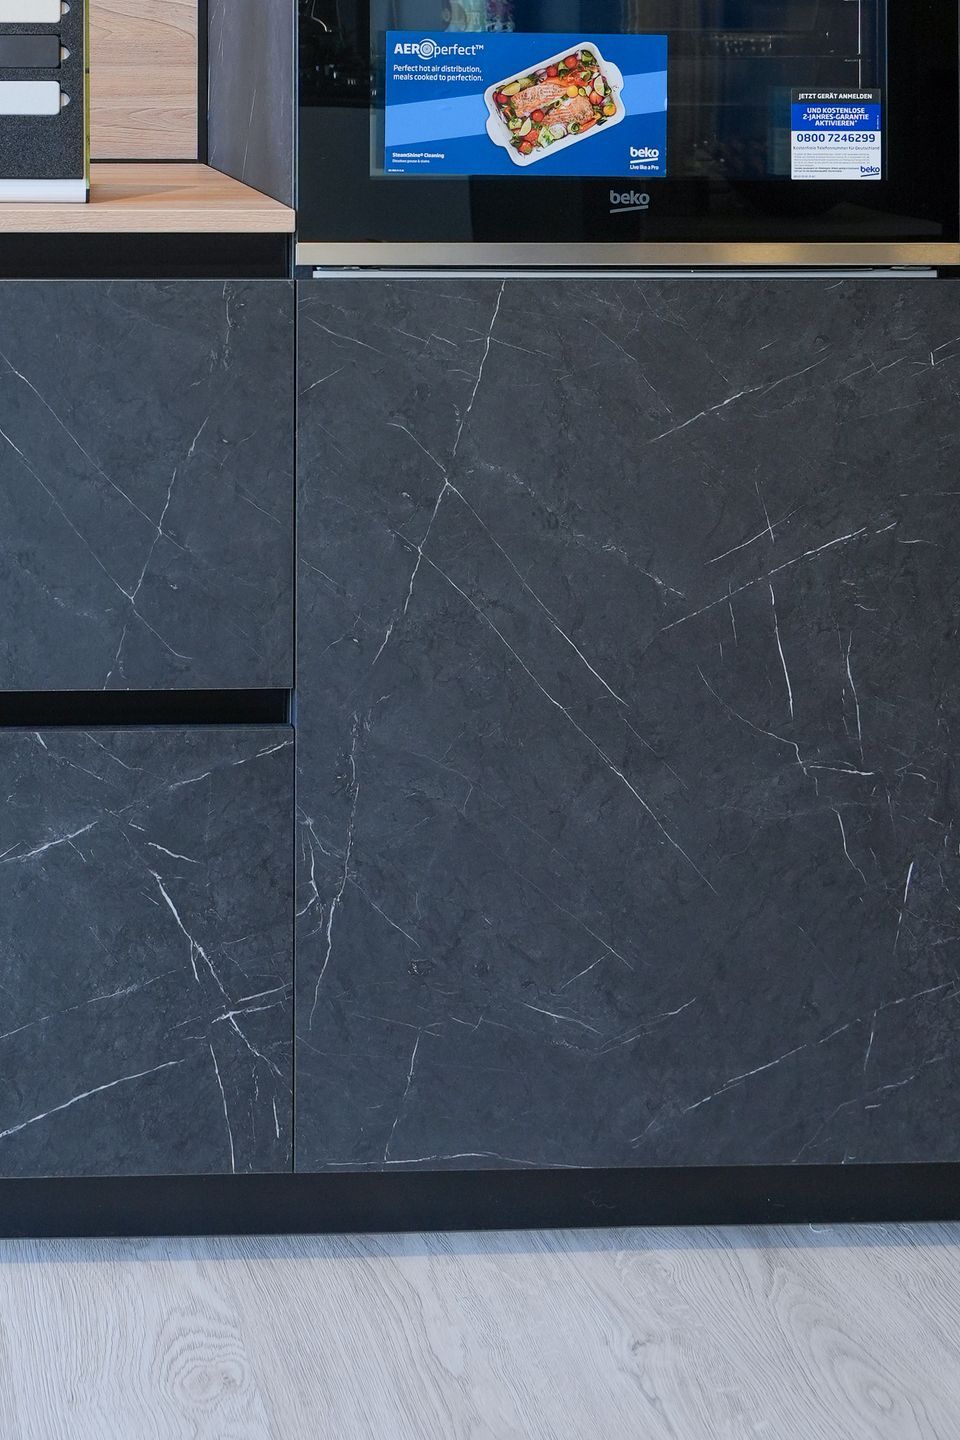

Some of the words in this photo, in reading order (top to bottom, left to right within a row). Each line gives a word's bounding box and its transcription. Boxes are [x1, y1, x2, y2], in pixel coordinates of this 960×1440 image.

[393, 64, 419, 72] Perfect
[419, 64, 431, 72] hot
[431, 64, 440, 72] air
[441, 64, 482, 73] distribution,
[393, 73, 413, 81] meals
[414, 73, 438, 81] cooked
[447, 74, 484, 82] perfection.
[817, 92, 838, 100] GERÄT
[802, 113, 869, 121] 2-JAHRES-GARANTIE
[796, 133, 826, 143] 0800
[827, 133, 876, 143] 7246299
[629, 146, 660, 157] beko
[860, 165, 881, 173] beko
[609, 189, 650, 205] beko
